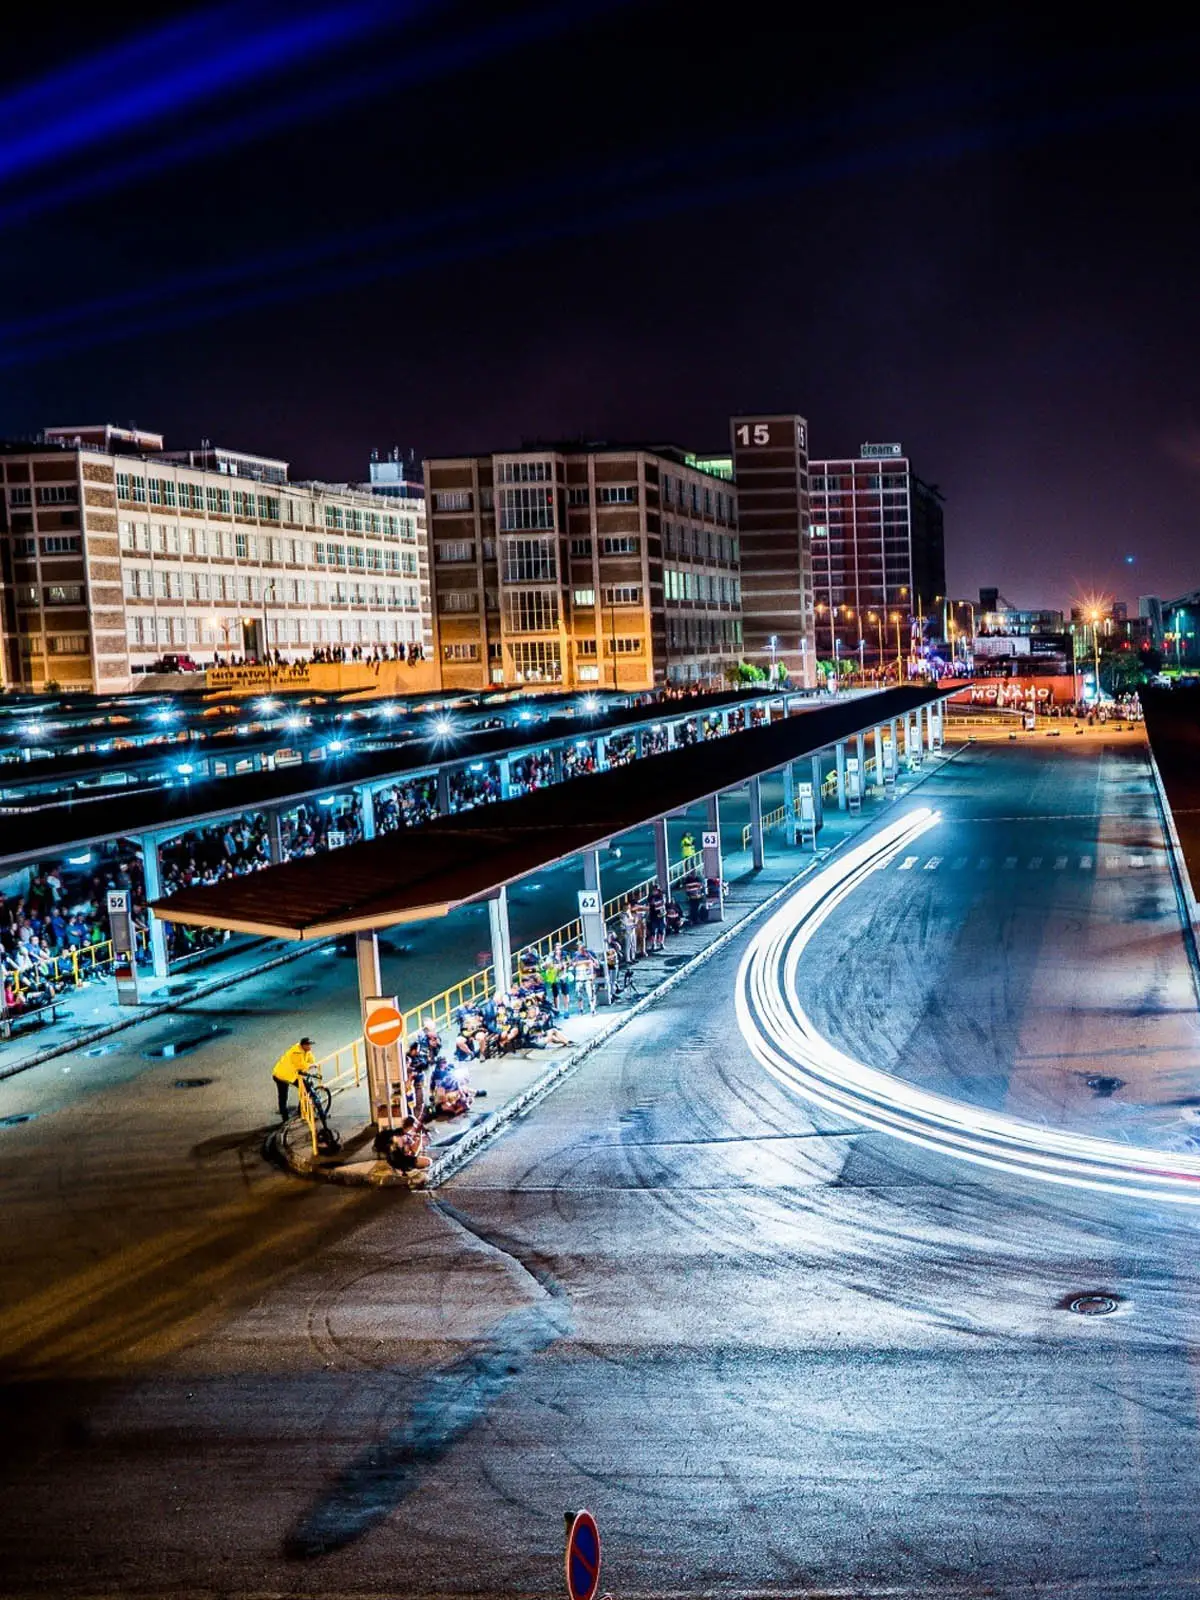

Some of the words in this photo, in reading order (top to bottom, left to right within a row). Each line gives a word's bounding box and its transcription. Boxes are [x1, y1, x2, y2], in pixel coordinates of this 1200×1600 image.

[737, 424, 770, 445] 15
[705, 835, 716, 844] 63
[111, 897, 124, 907] 52
[582, 898, 596, 908] 62
